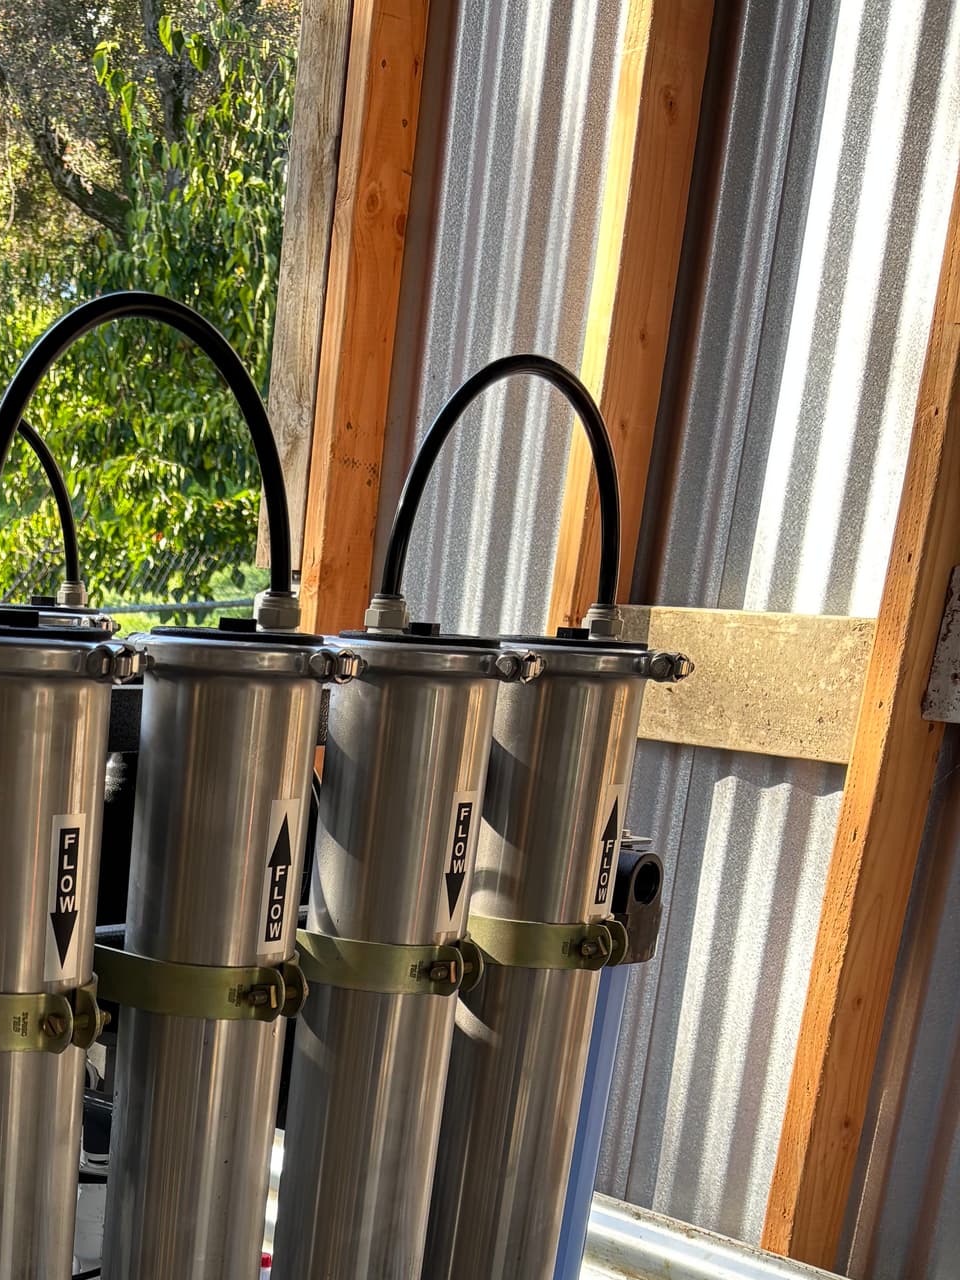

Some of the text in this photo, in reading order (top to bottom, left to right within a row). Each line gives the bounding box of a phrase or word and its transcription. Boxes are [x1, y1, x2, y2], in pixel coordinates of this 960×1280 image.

[60, 834, 76, 913] FLOW
[452, 808, 470, 874] FLOW
[598, 840, 614, 902] FLOW
[269, 865, 287, 938] FLOW
